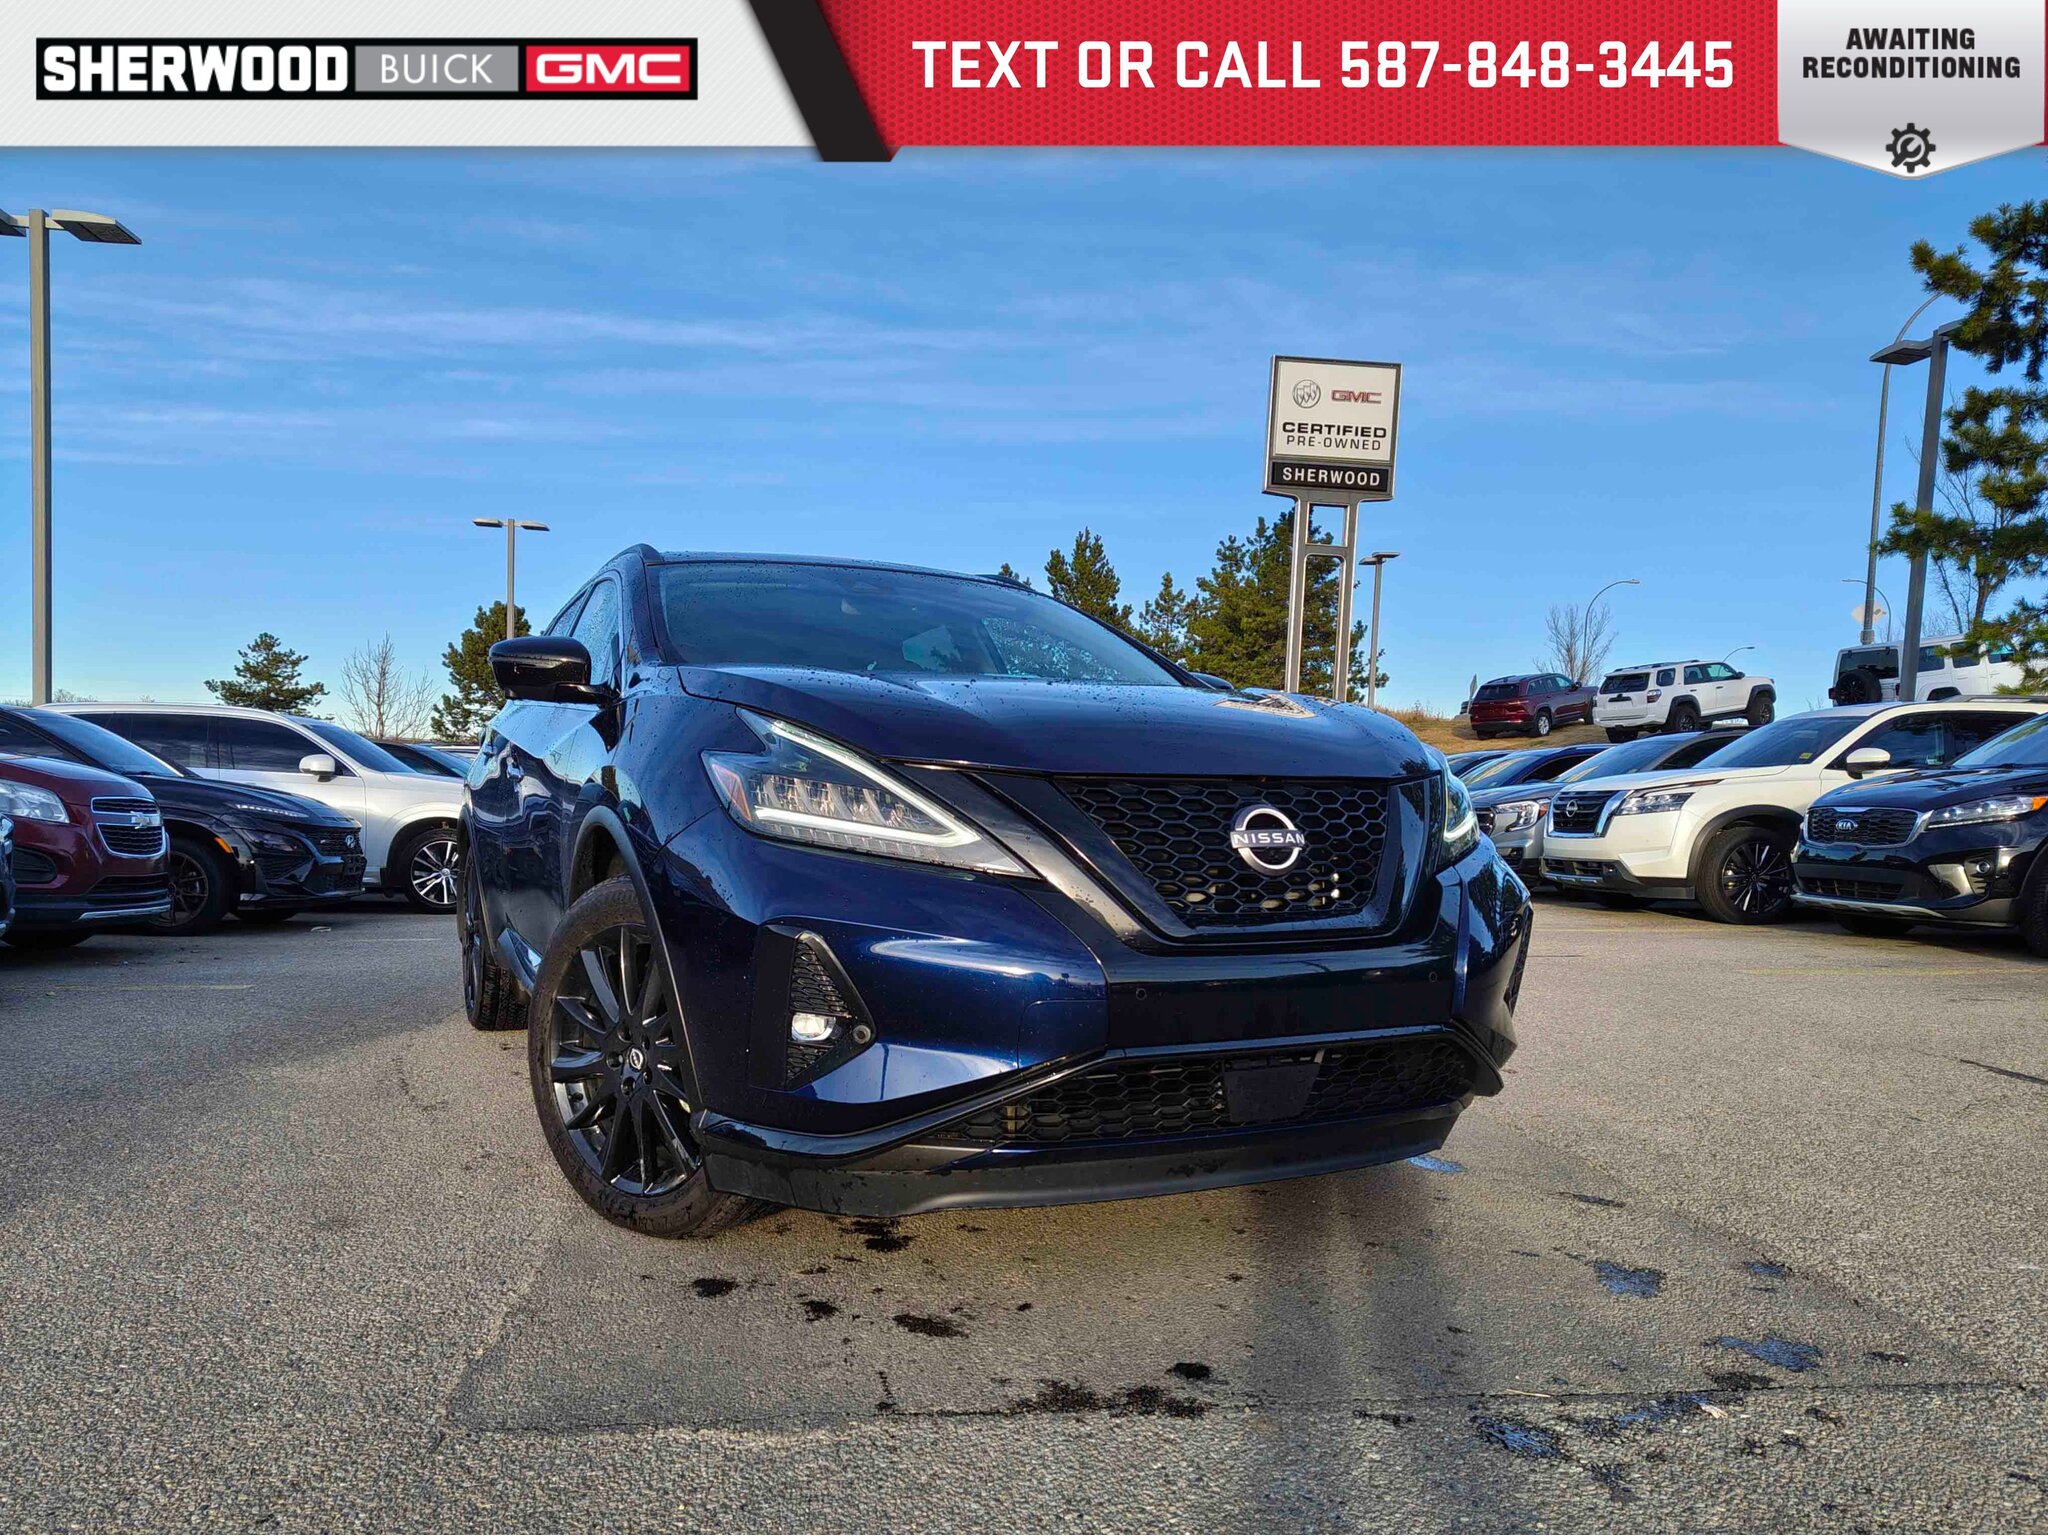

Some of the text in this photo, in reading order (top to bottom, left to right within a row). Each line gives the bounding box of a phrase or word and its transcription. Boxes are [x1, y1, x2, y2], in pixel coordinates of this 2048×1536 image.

[1331, 390, 1382, 404] GMC
[1282, 422, 1387, 438] CERTIFIED
[1286, 435, 1381, 450] PRE-OWNED
[1282, 467, 1380, 486] SHERWOOD
[1233, 832, 1305, 845] NISSAN
